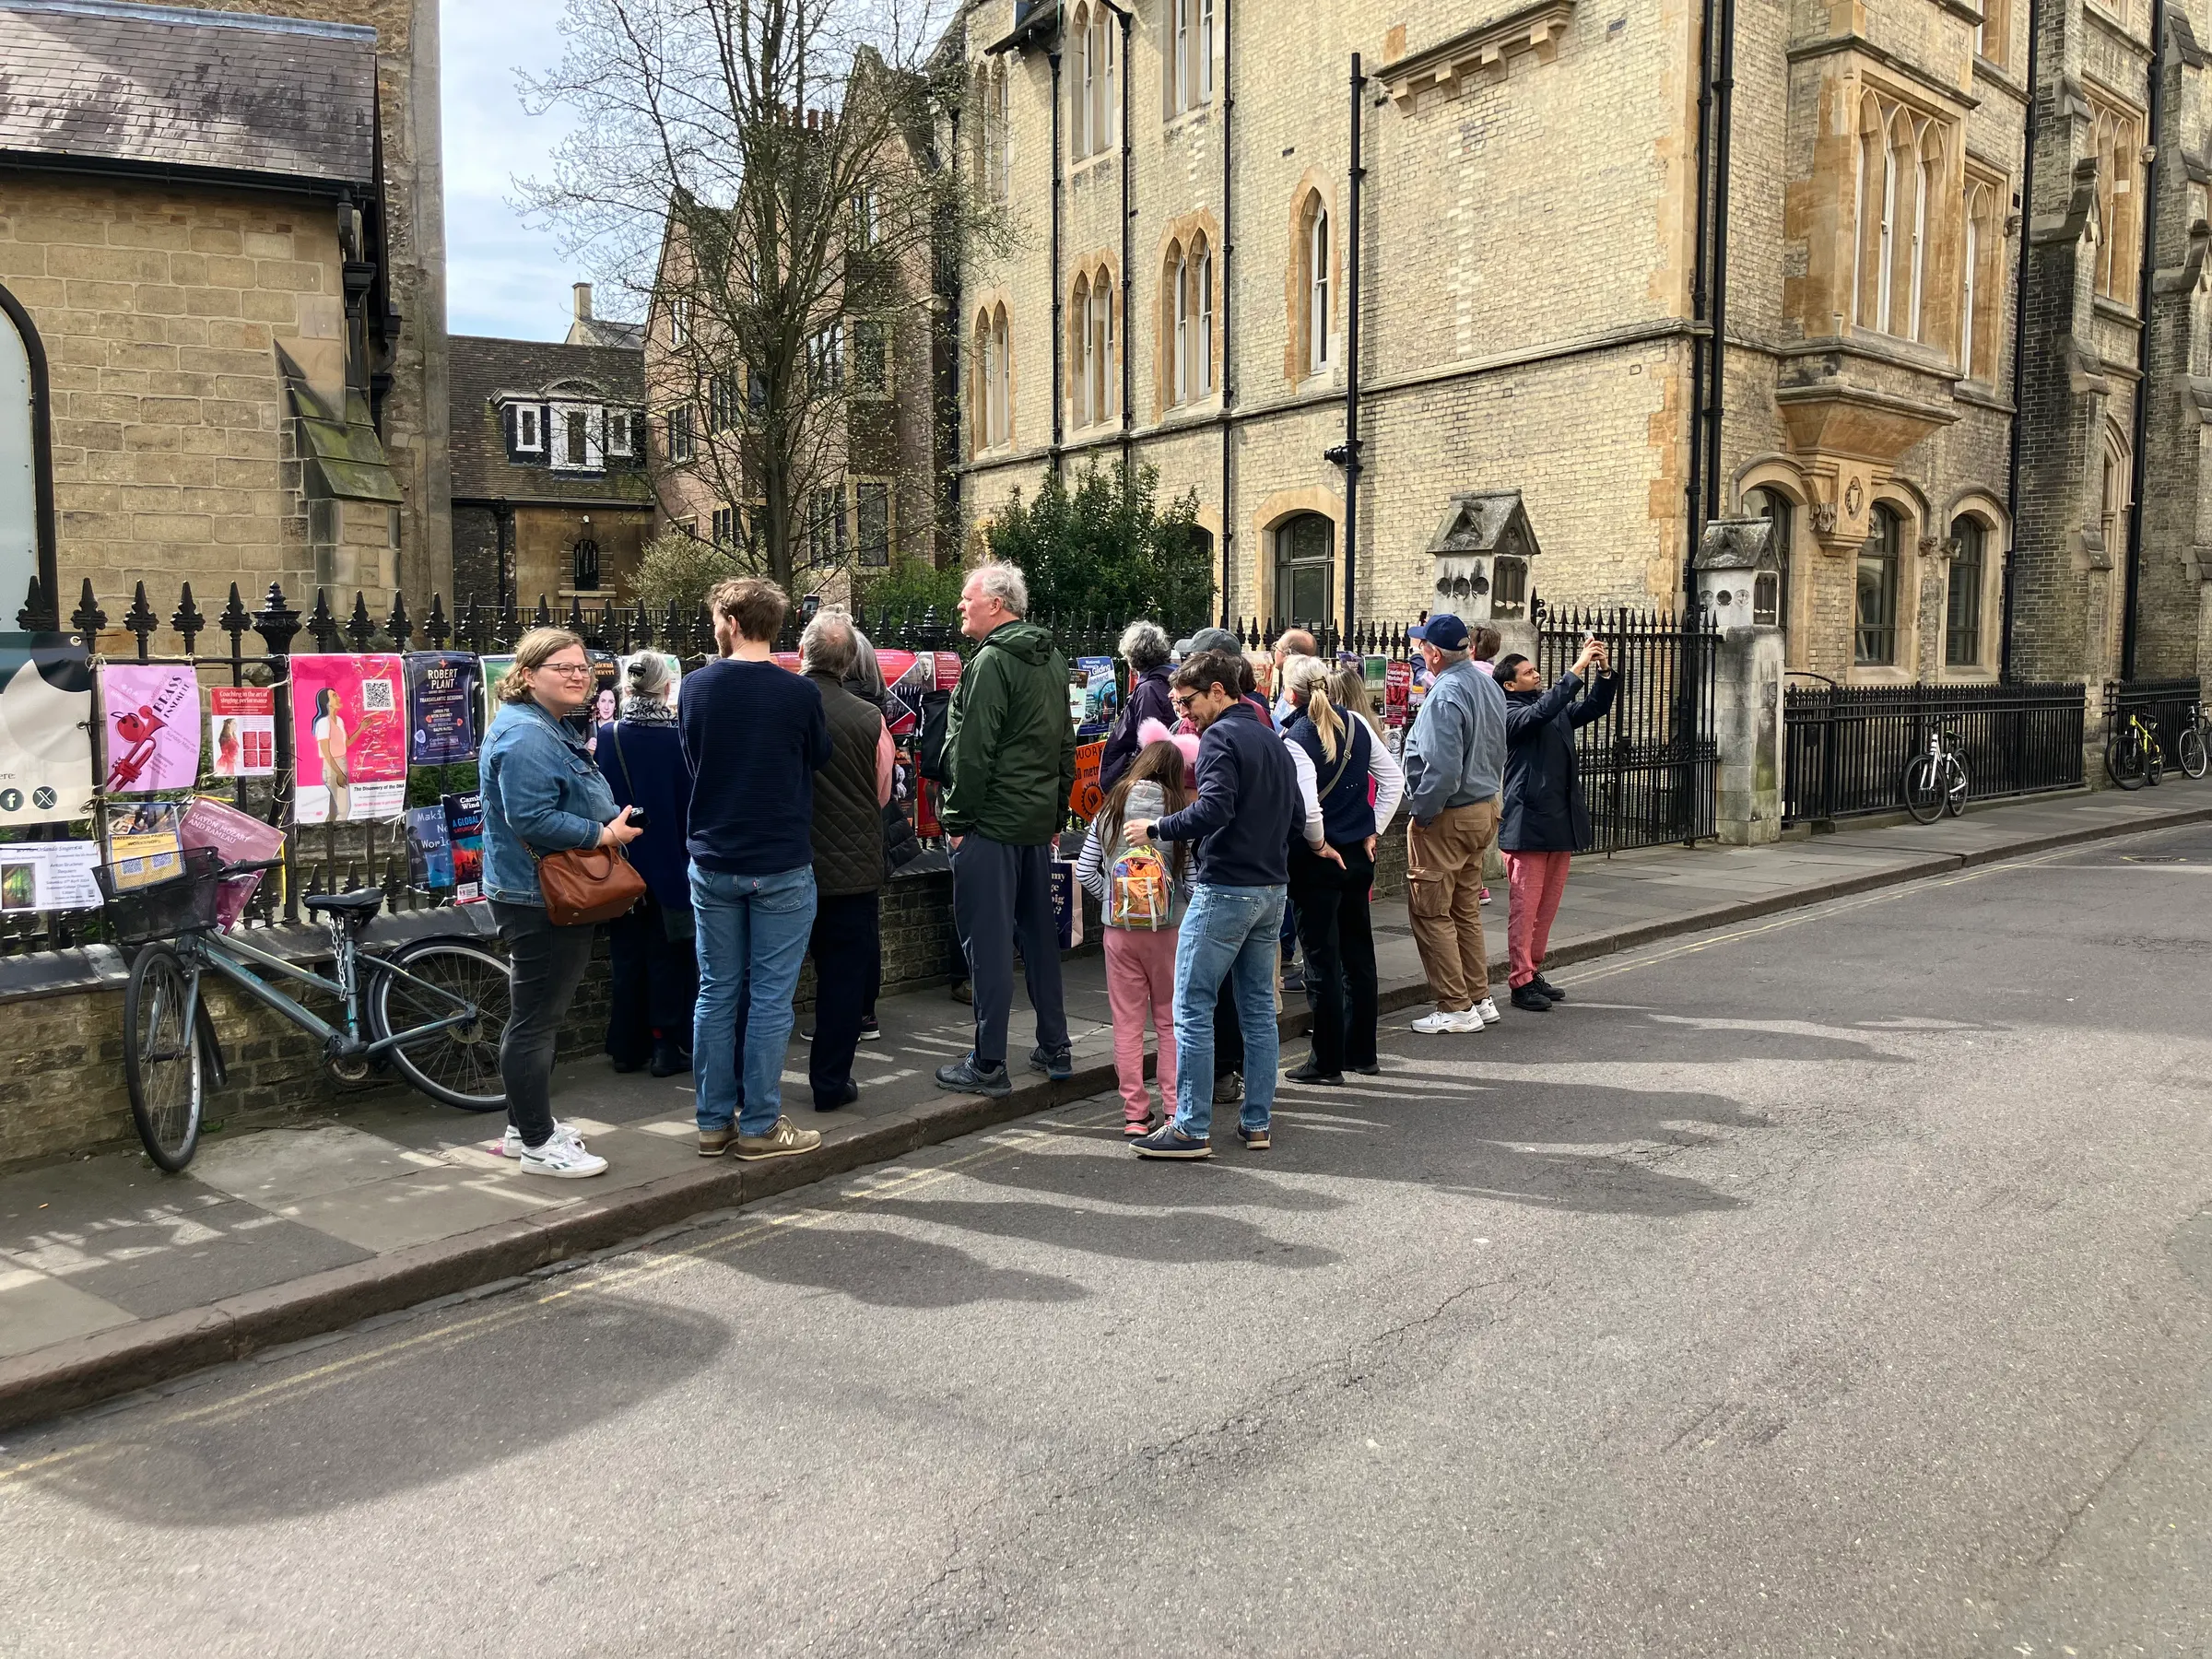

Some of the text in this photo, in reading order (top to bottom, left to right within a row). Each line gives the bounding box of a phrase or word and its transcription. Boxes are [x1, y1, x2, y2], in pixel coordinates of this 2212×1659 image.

[428, 668, 458, 680] ROBERT
[1092, 664, 1110, 675] Gliding
[431, 679, 455, 689] PLANT
[153, 675, 182, 713] BRASS
[461, 801, 480, 810] Wind
[192, 812, 218, 830] HAYDN,
[219, 825, 250, 843] MOZART
[453, 815, 479, 828] A GLOBAL
[188, 819, 205, 829] AND
[205, 826, 237, 844] RAMEAU
